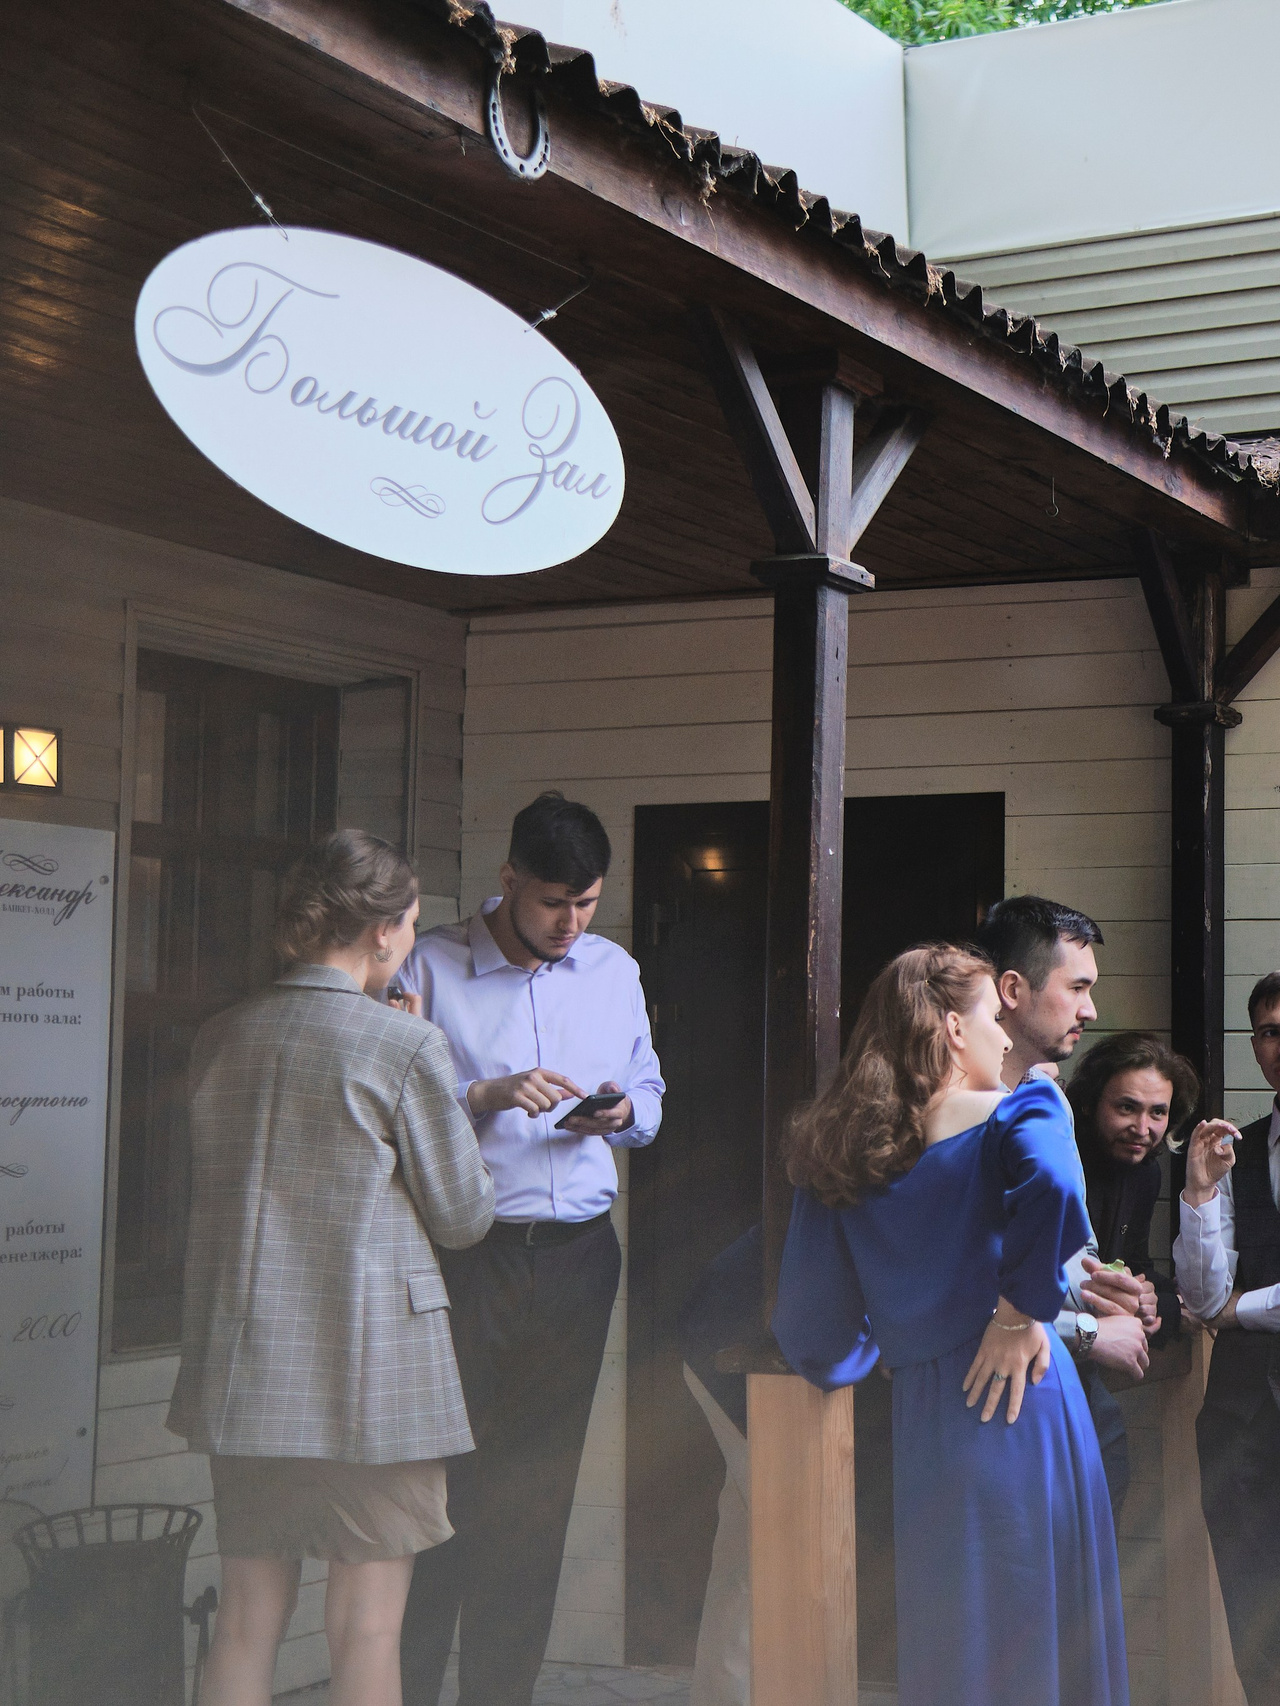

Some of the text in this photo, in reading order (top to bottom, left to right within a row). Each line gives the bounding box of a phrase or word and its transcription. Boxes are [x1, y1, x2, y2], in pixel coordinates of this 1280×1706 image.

[153, 262, 612, 526] Большой Зал
[16, 981, 75, 1002] работы
[0, 1012, 82, 1026] ного зала:
[0, 1096, 91, 1127] осуточно
[5, 1219, 66, 1242] работы
[12, 1311, 82, 1343] 20.00
